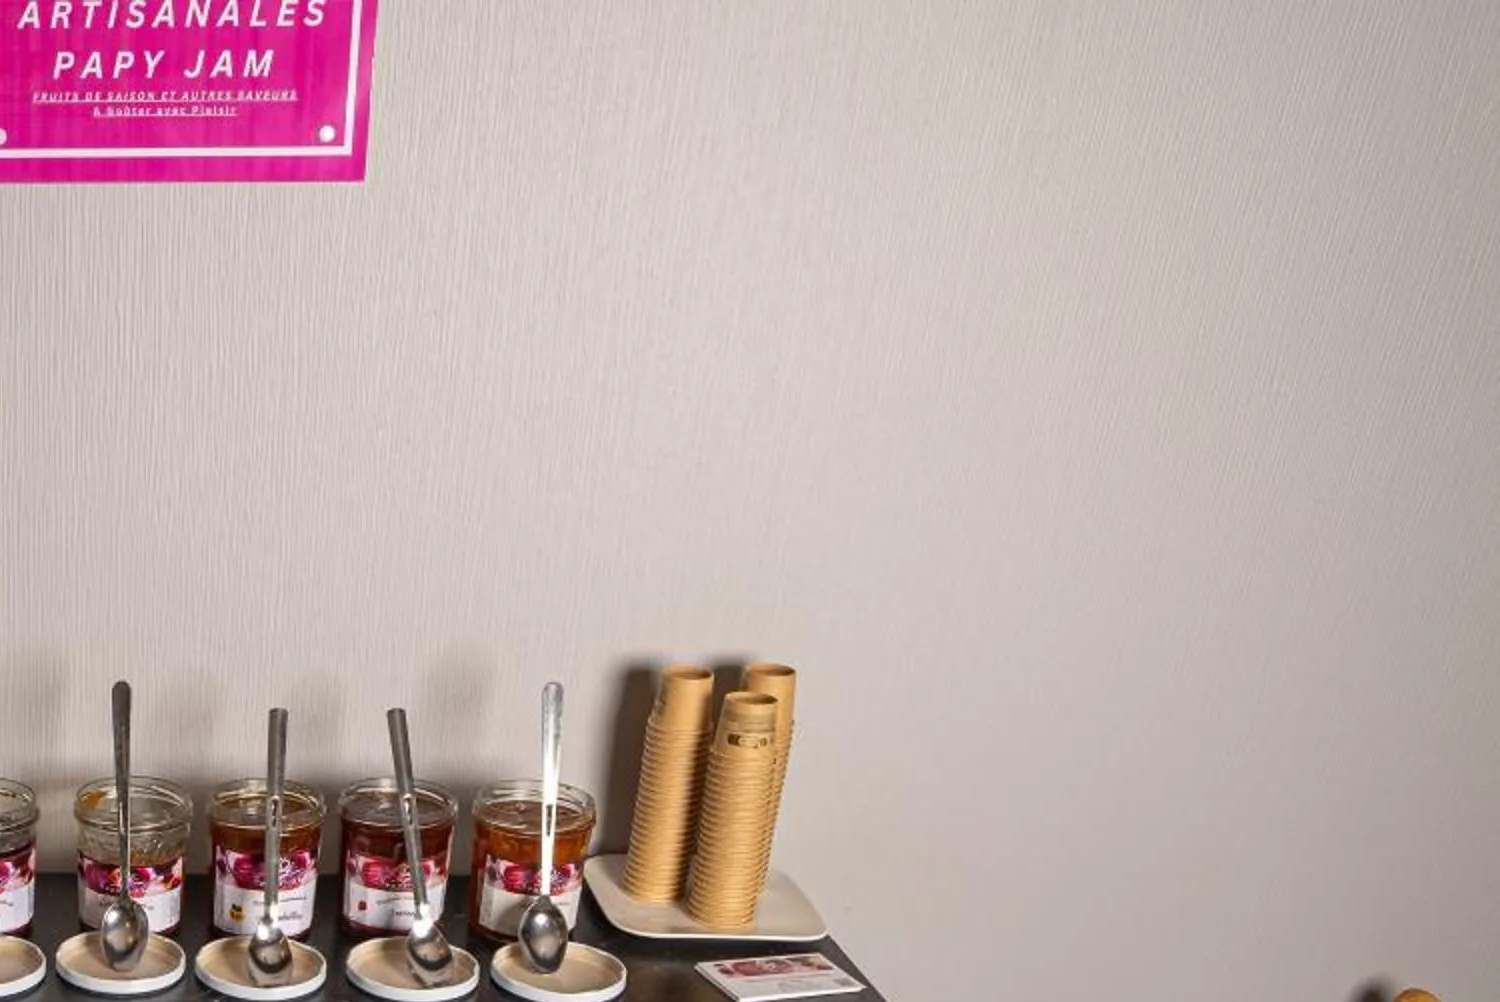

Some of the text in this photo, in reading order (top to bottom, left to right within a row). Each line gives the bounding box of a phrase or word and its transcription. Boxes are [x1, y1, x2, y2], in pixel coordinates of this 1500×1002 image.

[17, 0, 327, 29] ARTISANALES
[53, 49, 274, 79] PAPY JAM
[32, 88, 298, 102] FRUITS DE SAISON ET AUTRES SAVEURS
